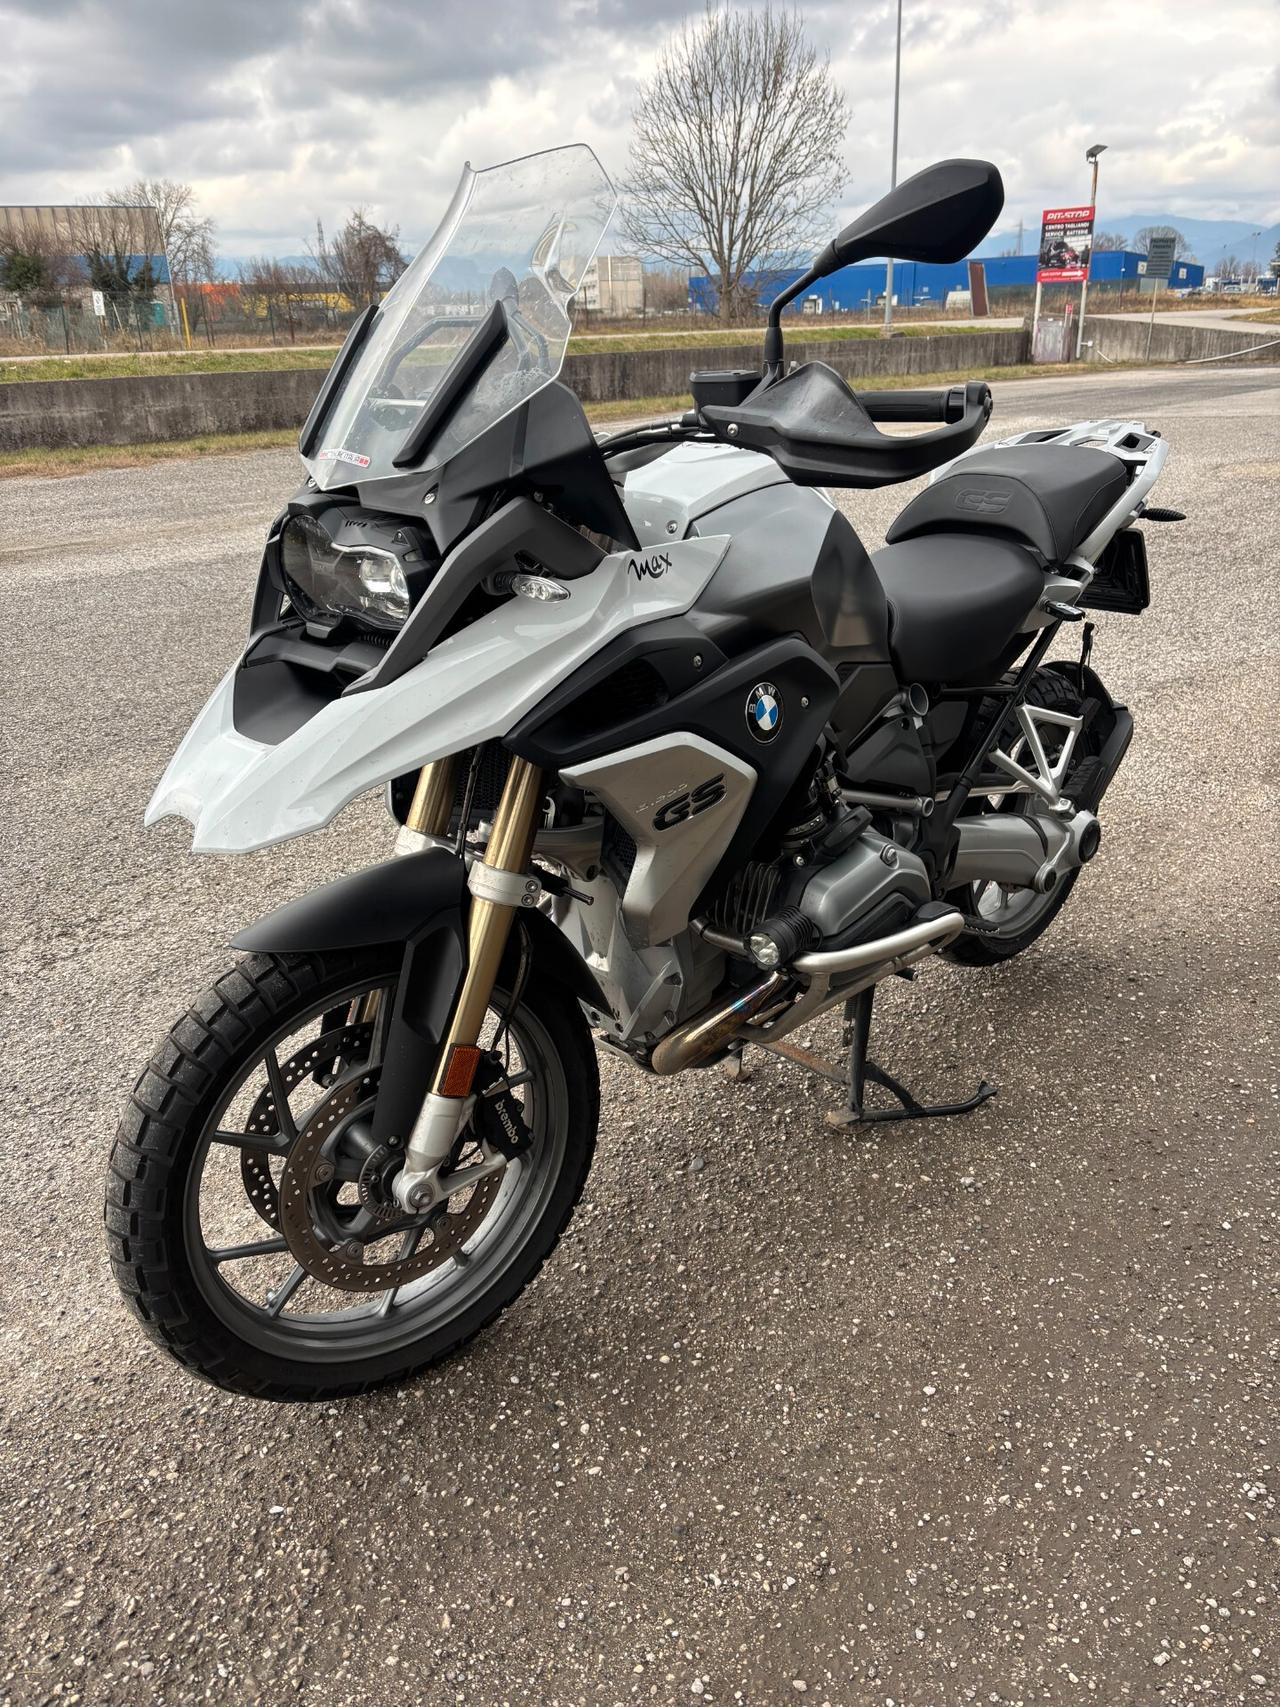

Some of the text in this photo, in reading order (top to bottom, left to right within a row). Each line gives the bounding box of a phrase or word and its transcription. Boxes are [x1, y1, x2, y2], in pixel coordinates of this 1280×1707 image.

[749, 685, 776, 713] BMW
[652, 772, 728, 832] GS
[494, 1099, 519, 1144] brembo
